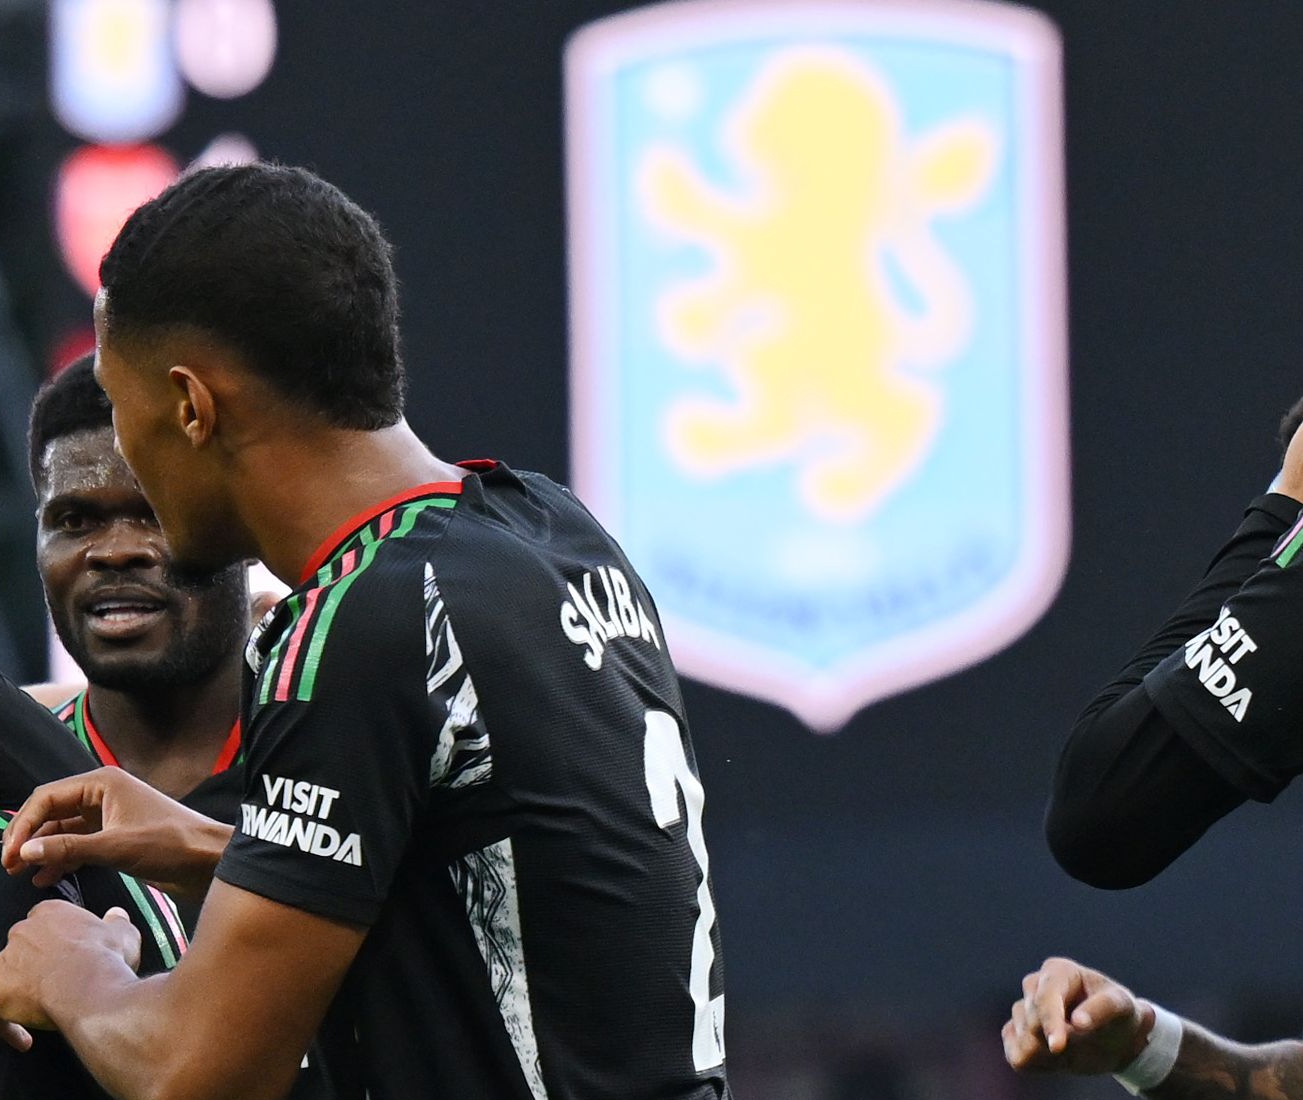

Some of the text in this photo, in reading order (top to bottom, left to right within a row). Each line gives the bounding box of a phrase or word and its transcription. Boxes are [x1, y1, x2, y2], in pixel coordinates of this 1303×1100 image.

[560, 565, 660, 671] SALIBA
[241, 803, 362, 866] RWANDA
[262, 774, 340, 819] VISIT
[644, 710, 726, 1072] 2
